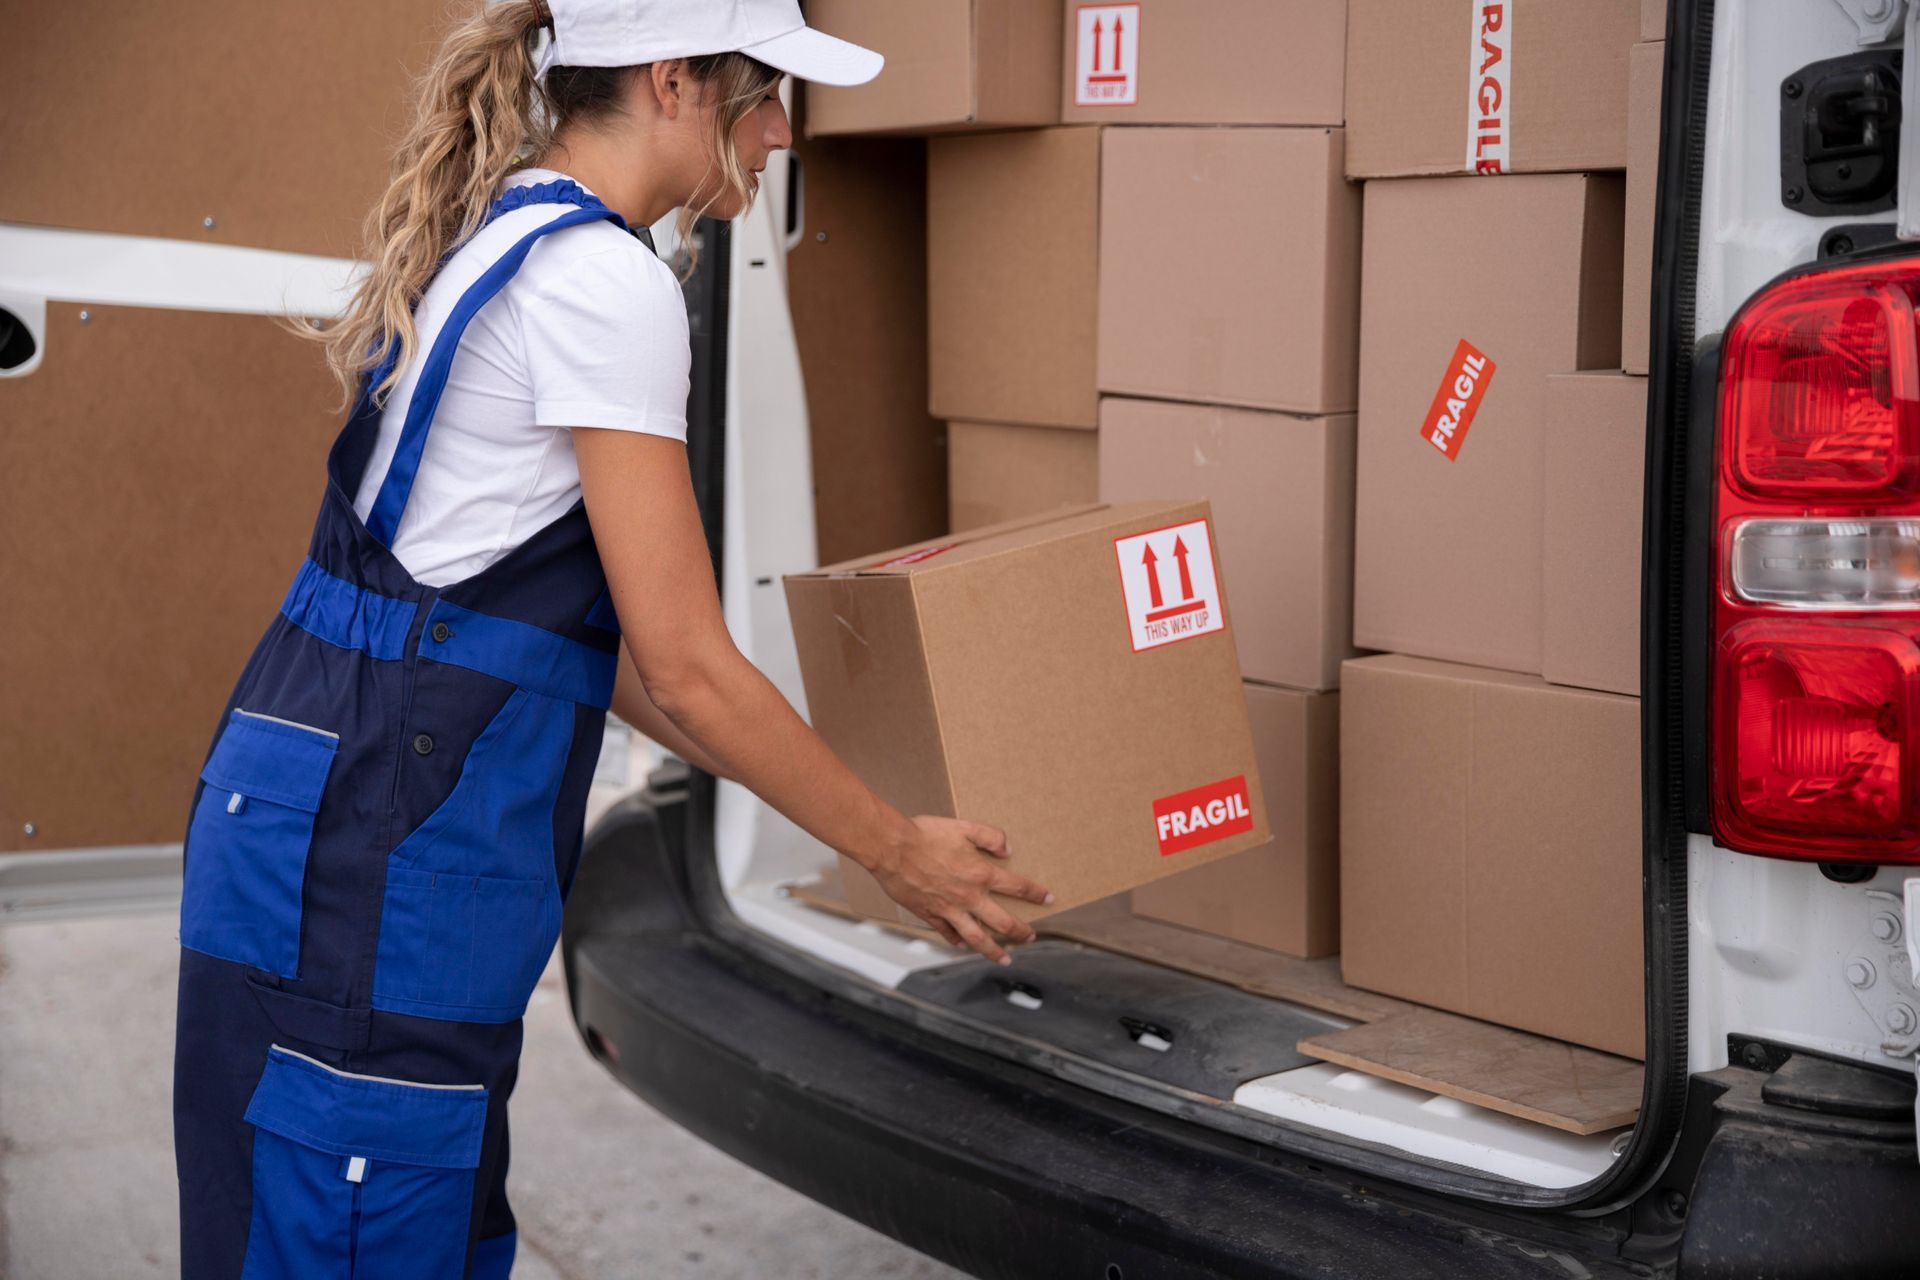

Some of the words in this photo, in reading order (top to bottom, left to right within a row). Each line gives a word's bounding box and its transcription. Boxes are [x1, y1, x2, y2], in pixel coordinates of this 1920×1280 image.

[1430, 354, 1487, 452] FRAGIL
[1144, 620, 1169, 641] THIS
[1169, 614, 1193, 634] WAY
[1194, 610, 1209, 629] UP
[1156, 793, 1249, 841] FRAGIL
